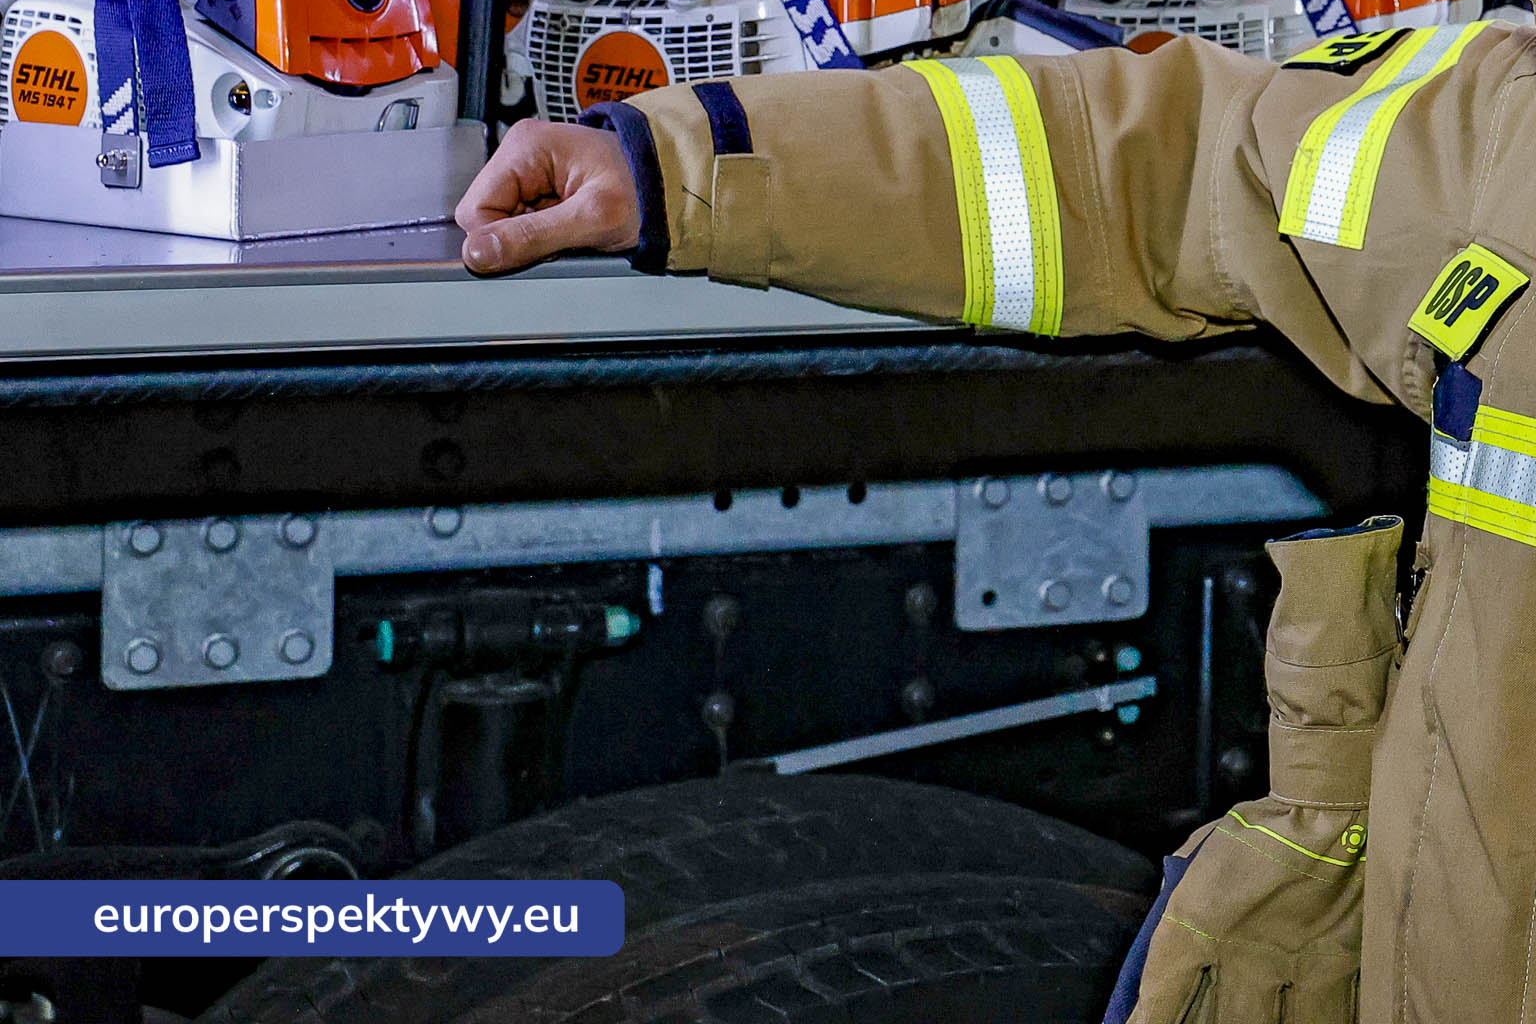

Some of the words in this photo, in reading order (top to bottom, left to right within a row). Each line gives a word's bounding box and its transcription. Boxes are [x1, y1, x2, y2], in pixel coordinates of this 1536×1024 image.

[16, 63, 80, 93] STIHL
[583, 63, 659, 89] STIHL
[18, 89, 41, 105] MS
[43, 93, 65, 109] 194
[67, 96, 77, 110] T
[1425, 260, 1500, 328] OSP
